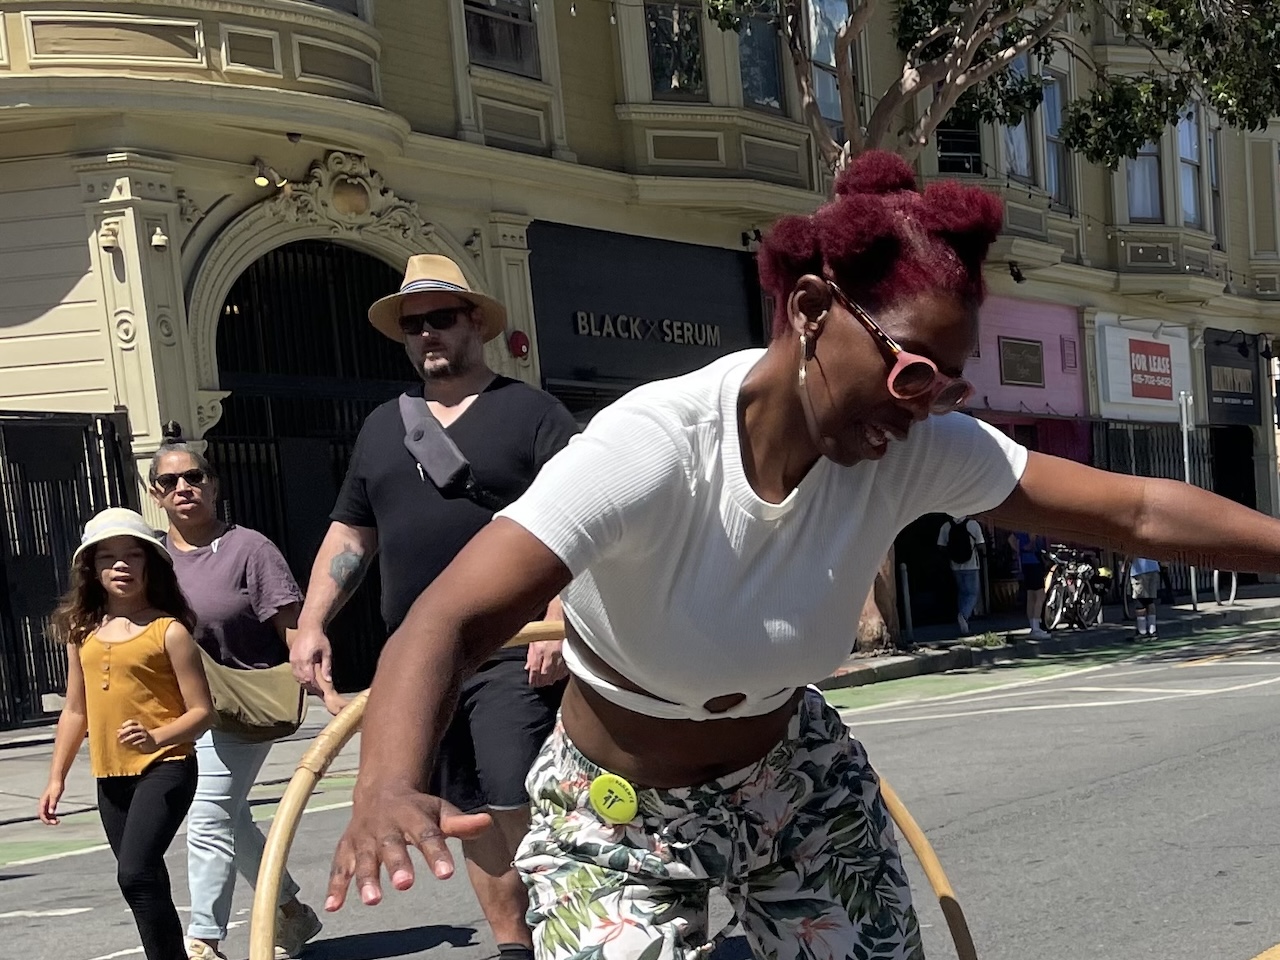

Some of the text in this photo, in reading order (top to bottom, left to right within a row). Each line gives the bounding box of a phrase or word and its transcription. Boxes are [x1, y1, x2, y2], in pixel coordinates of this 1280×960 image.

[575, 310, 643, 340] BLACK
[662, 318, 721, 347] SERUM
[1131, 352, 1171, 374] FOR LEASE
